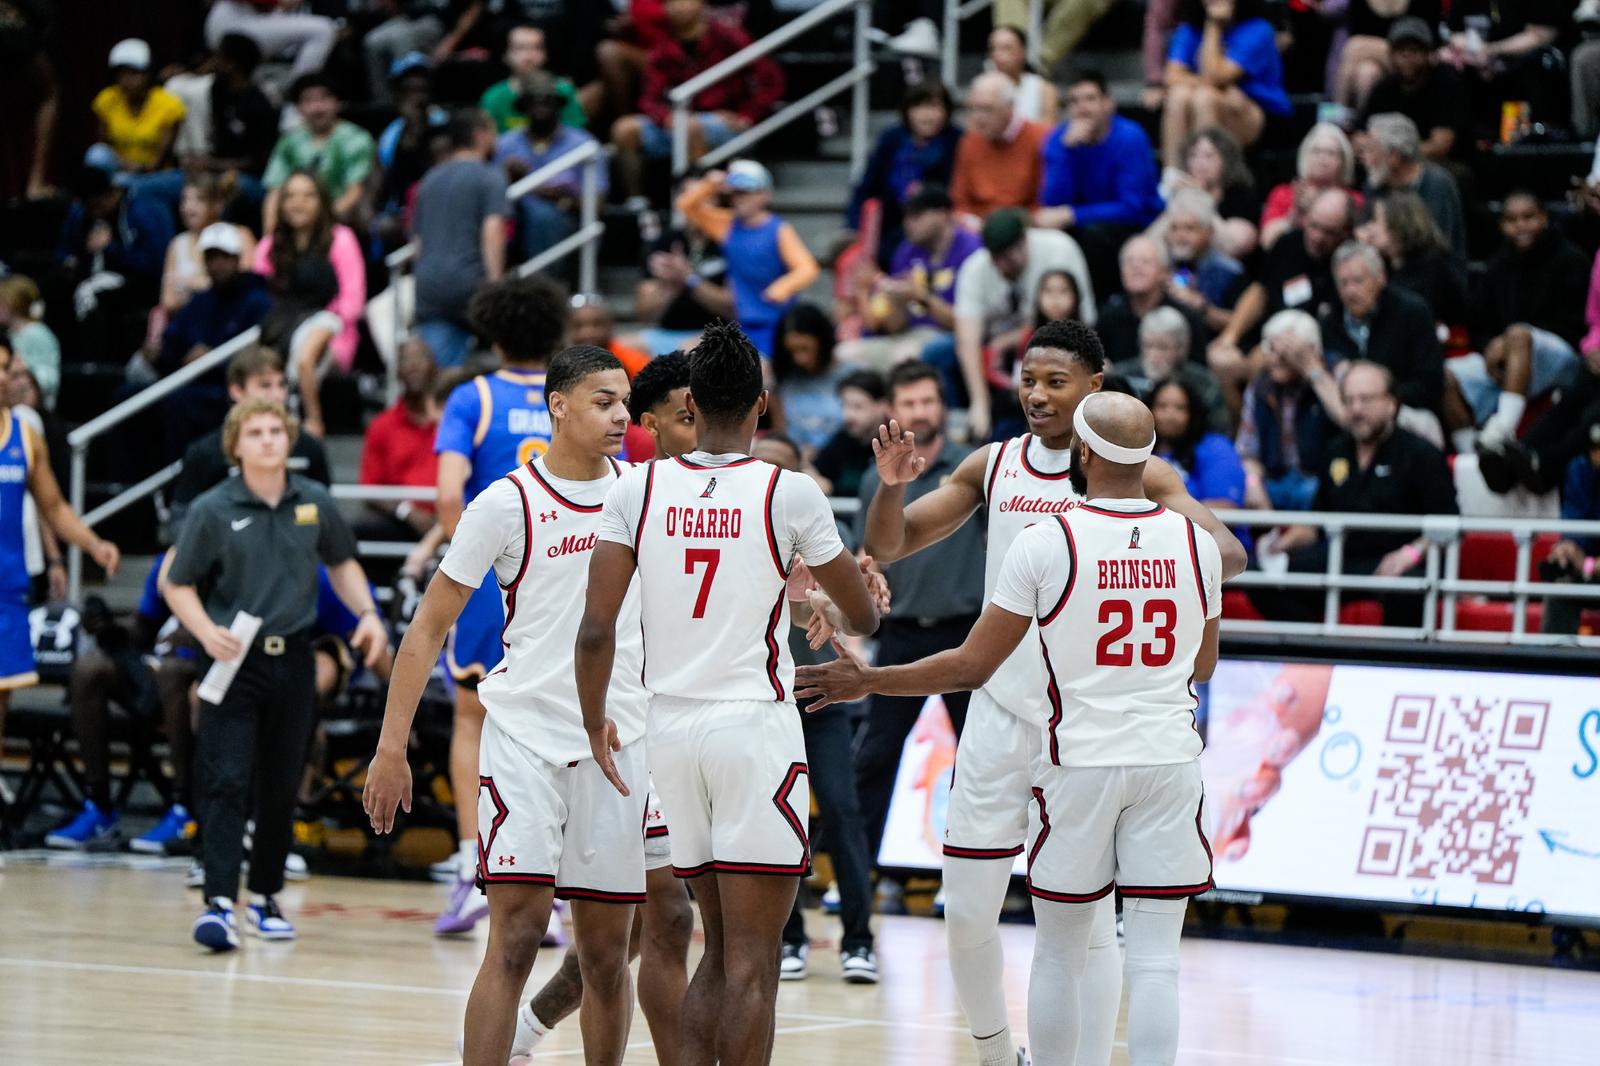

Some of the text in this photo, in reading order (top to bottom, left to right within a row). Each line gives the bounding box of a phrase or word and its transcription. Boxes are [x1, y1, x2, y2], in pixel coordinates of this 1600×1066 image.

[666, 506, 742, 539] O'GARRO
[547, 532, 600, 558] Mat
[684, 548, 721, 619] 7
[1097, 558, 1176, 590] BRINSON
[1096, 599, 1178, 667] 23
